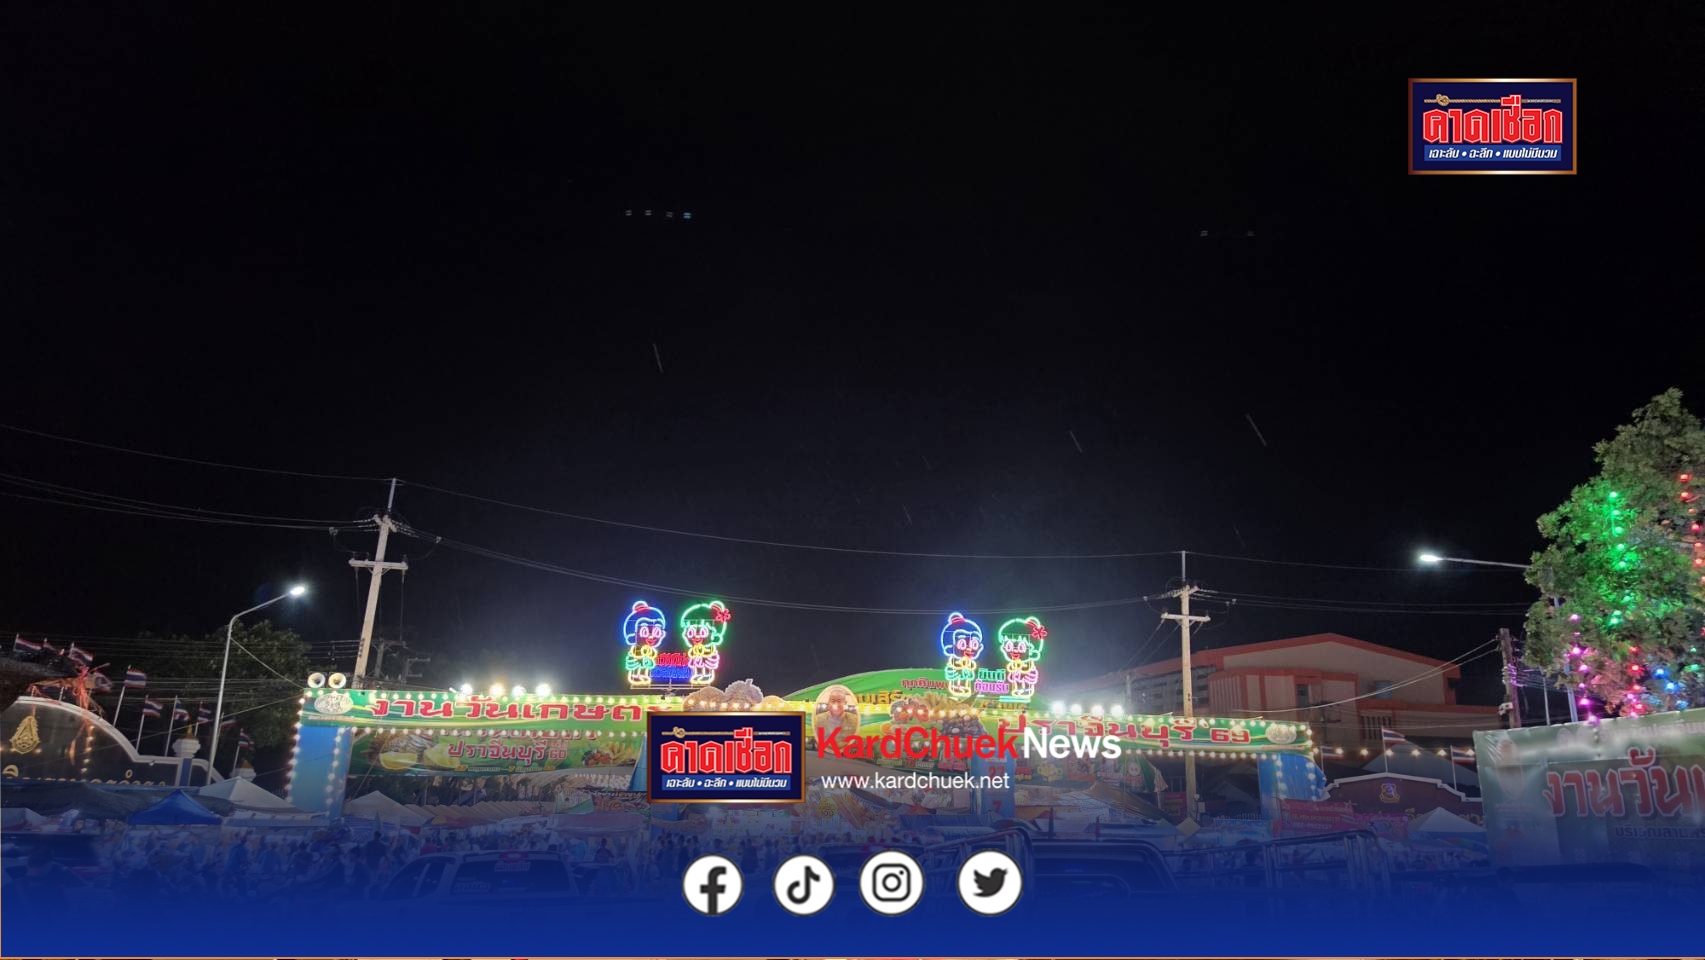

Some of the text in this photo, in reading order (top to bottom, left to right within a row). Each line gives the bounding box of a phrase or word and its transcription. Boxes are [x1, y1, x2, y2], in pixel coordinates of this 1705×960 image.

[371, 696, 673, 720] งานวันเกษต
[447, 738, 549, 768] ปราจีนบุรี
